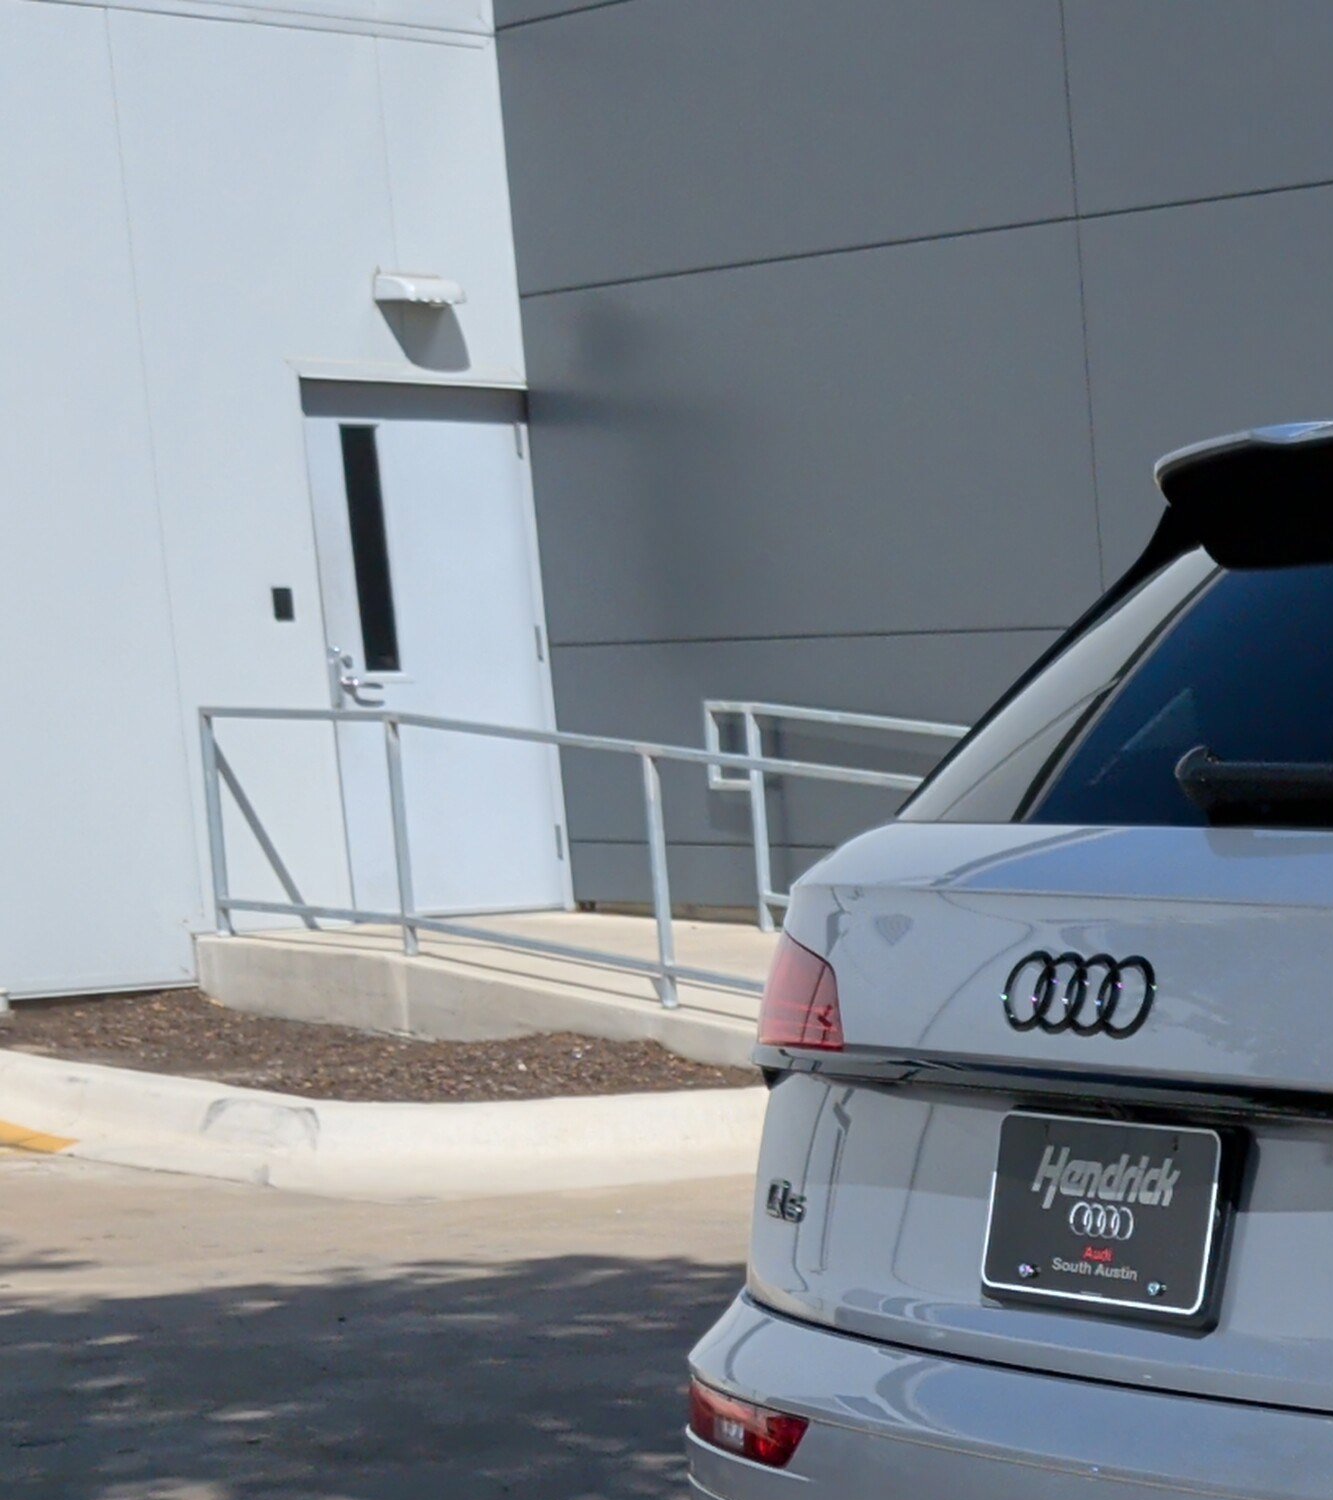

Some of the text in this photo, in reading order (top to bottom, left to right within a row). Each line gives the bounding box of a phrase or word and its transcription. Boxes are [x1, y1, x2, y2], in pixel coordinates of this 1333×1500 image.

[1031, 1145, 1181, 1208] Hendrick
[1083, 1246, 1114, 1262] Audi
[1051, 1257, 1138, 1281] South Austin
